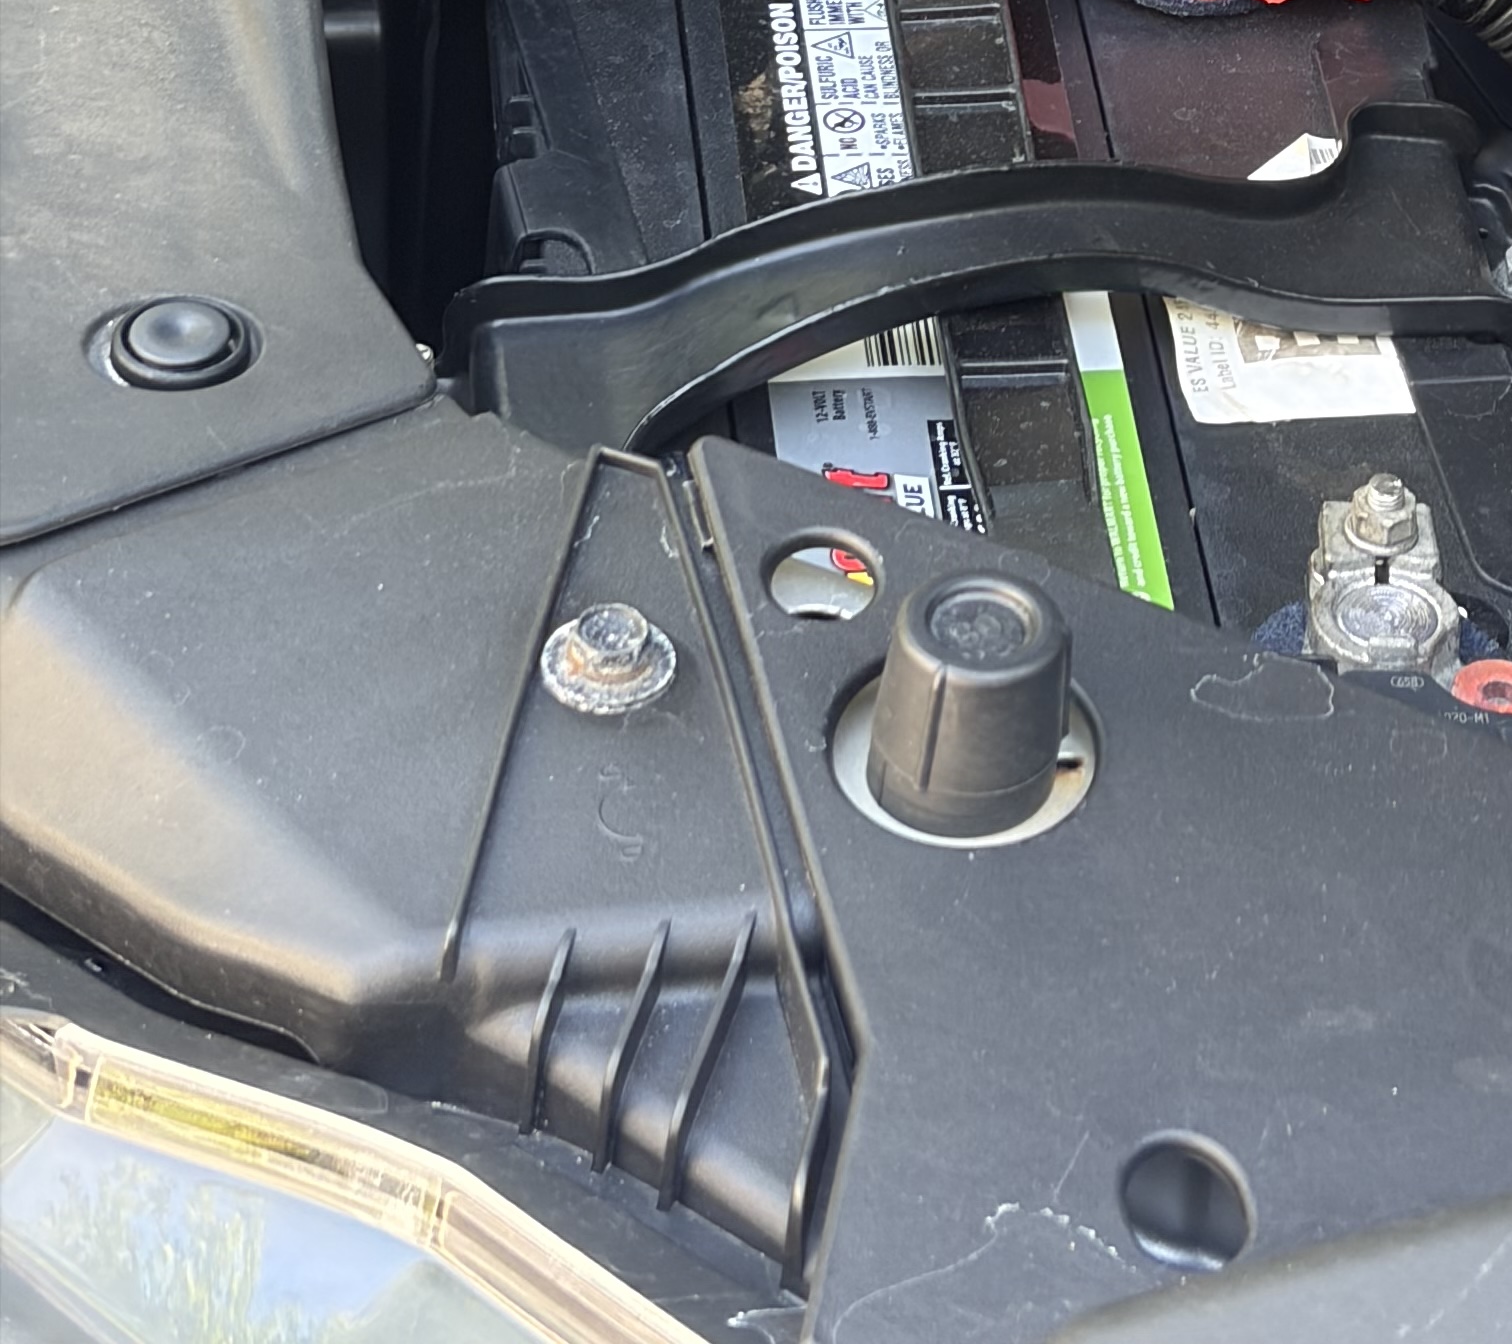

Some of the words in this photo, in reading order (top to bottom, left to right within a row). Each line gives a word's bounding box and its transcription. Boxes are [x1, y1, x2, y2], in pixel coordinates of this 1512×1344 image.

[807, 0, 827, 26] FLUSH
[844, 0, 865, 25] WITH
[874, 40, 891, 54] OR
[815, 55, 840, 100] SULFURIC
[857, 54, 877, 80] CAUSE
[877, 55, 901, 100] BLINDNESS
[768, 2, 817, 172] DANGER/POISON
[841, 77, 859, 100] ACID
[862, 80, 881, 100] CAN
[838, 136, 859, 150] NO
[1177, 323, 1201, 372] VALUE
[1190, 372, 1210, 394] ES
[1211, 358, 1237, 391] Label
[812, 390, 829, 424] 12-VOLT
[832, 389, 847, 421] Battery
